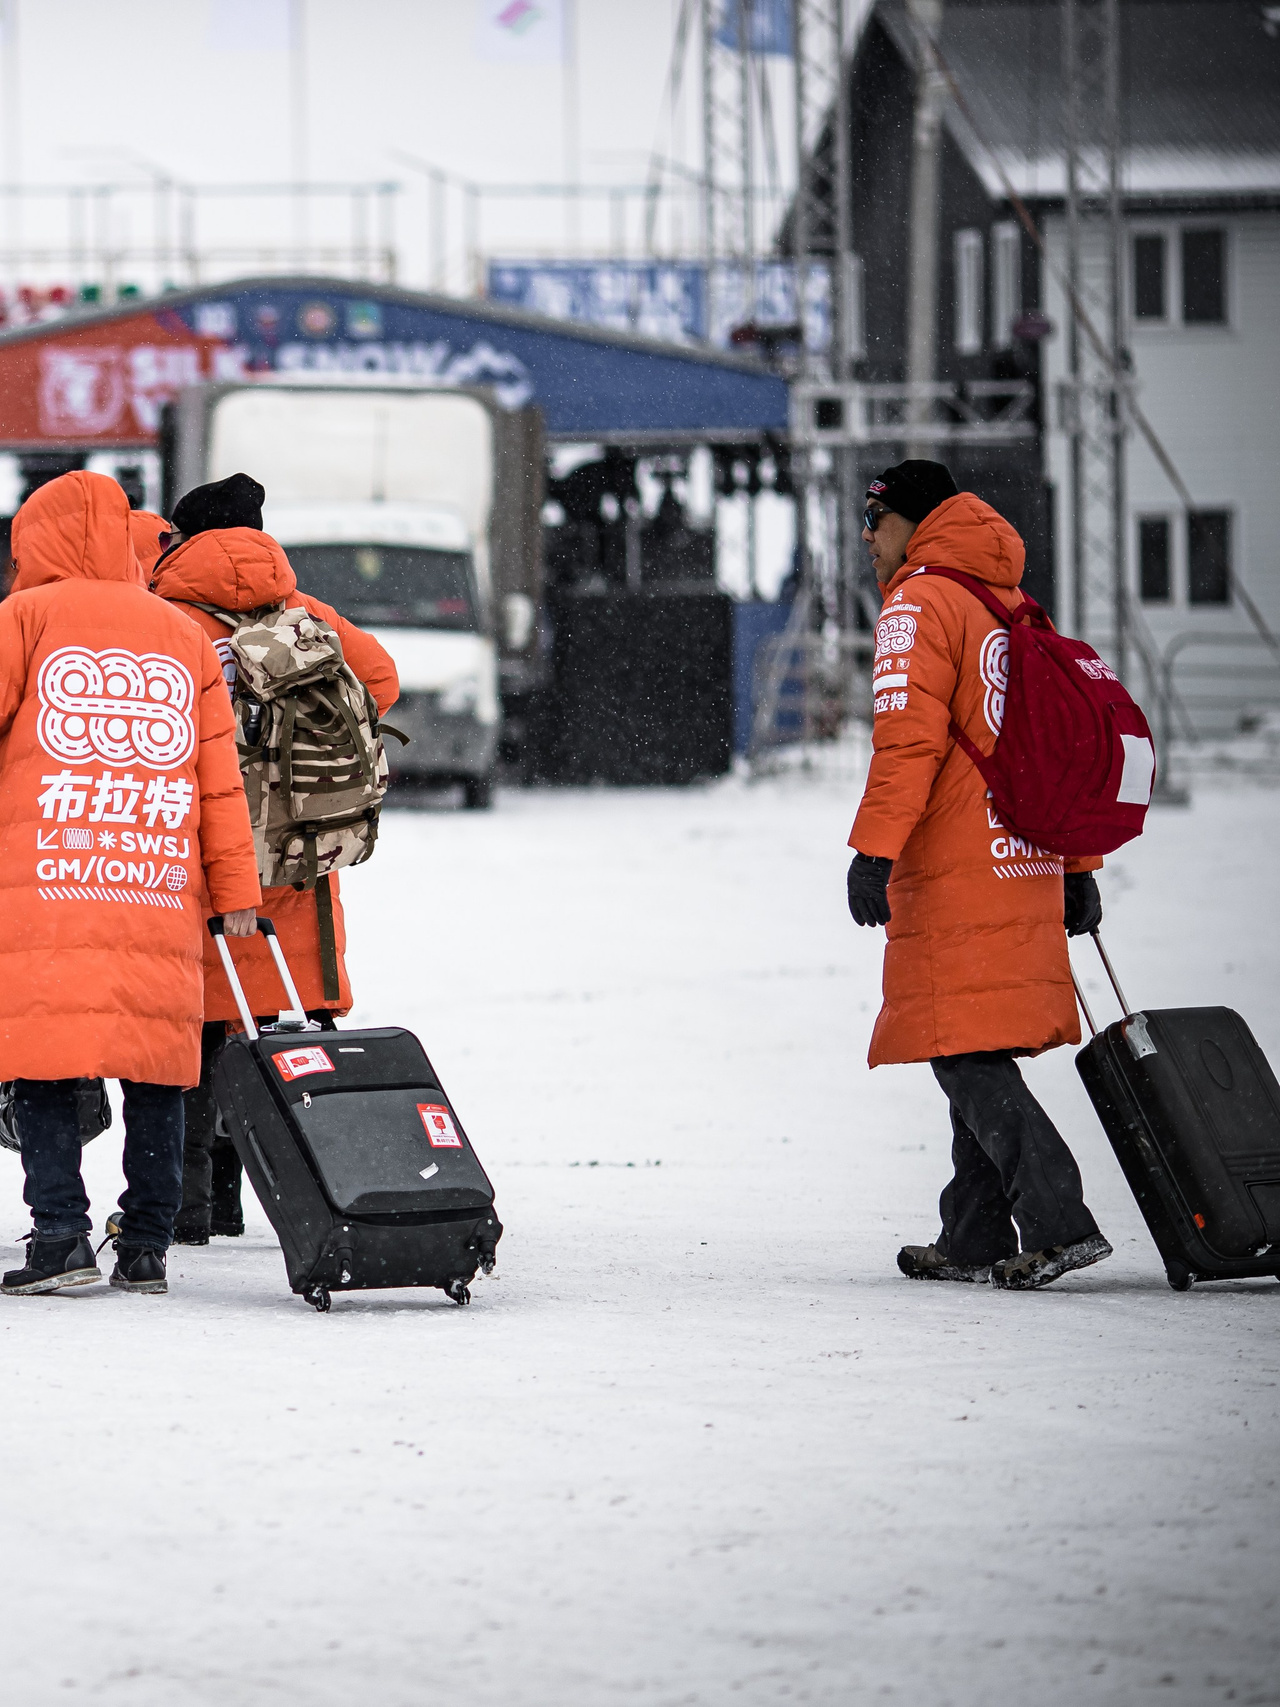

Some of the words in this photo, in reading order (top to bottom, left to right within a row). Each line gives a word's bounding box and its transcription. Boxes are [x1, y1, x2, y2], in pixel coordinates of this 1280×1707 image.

[873, 691, 908, 714] 拉特
[36, 769, 195, 830] 布拉特
[120, 830, 191, 860] SWSJ
